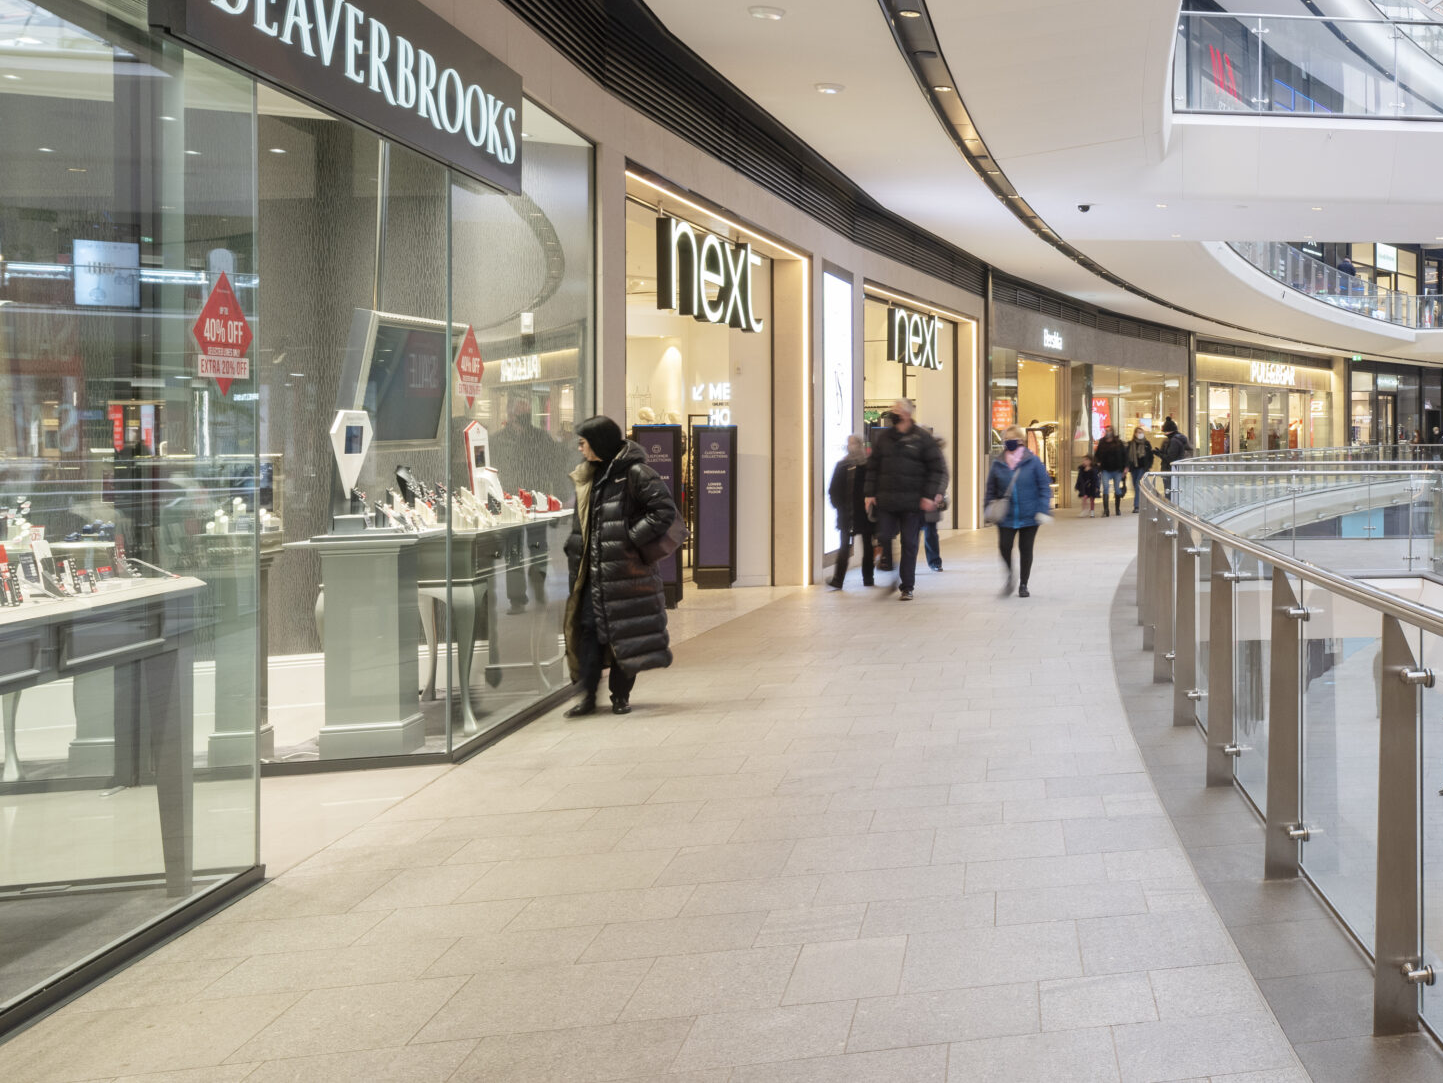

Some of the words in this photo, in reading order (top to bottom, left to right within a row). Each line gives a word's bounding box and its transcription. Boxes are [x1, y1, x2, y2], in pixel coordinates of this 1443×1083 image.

[670, 217, 762, 332] next
[204, 318, 225, 342] 40%
[228, 321, 243, 344] OFF
[894, 308, 943, 371] next
[201, 359, 220, 373] EXTRA
[222, 361, 235, 374] 20%
[237, 362, 247, 374] OFF
